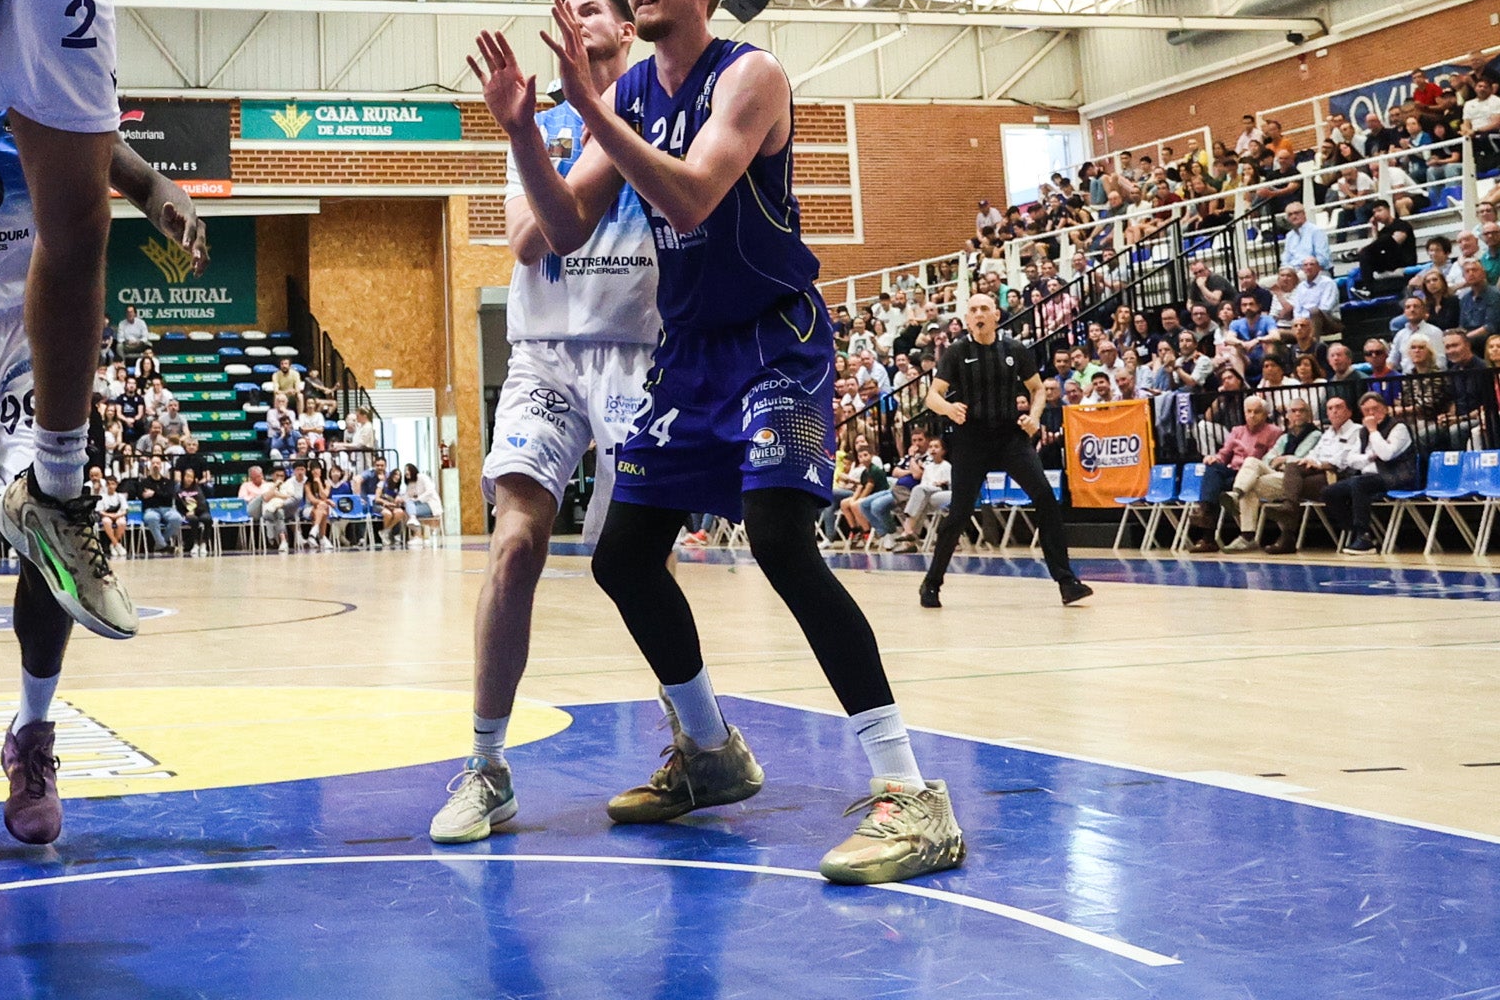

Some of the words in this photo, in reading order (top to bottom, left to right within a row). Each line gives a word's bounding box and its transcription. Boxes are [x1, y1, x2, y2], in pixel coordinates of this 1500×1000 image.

[315, 106, 359, 122] CAJA
[362, 106, 423, 122] RURAL
[317, 125, 334, 135] DE
[336, 125, 393, 136] ASTURIAS
[651, 110, 686, 150] 24
[182, 184, 223, 194] SUEÑOS
[566, 256, 654, 268] EXTREMADURA
[565, 268, 586, 276] NEW
[587, 267, 630, 276] ENERGIES
[118, 288, 164, 304] CAJA
[169, 288, 232, 303] RURAL
[137, 309, 153, 319] DE
[156, 308, 215, 319] ASTURIAS
[749, 379, 790, 399] OVIEDO
[753, 396, 794, 412] Asturias
[525, 406, 568, 431] TOYOTA
[632, 392, 680, 447] 24
[750, 447, 784, 459] OVIEDO
[1082, 436, 1140, 458] OVIEDO
[617, 461, 645, 476] ERKA
